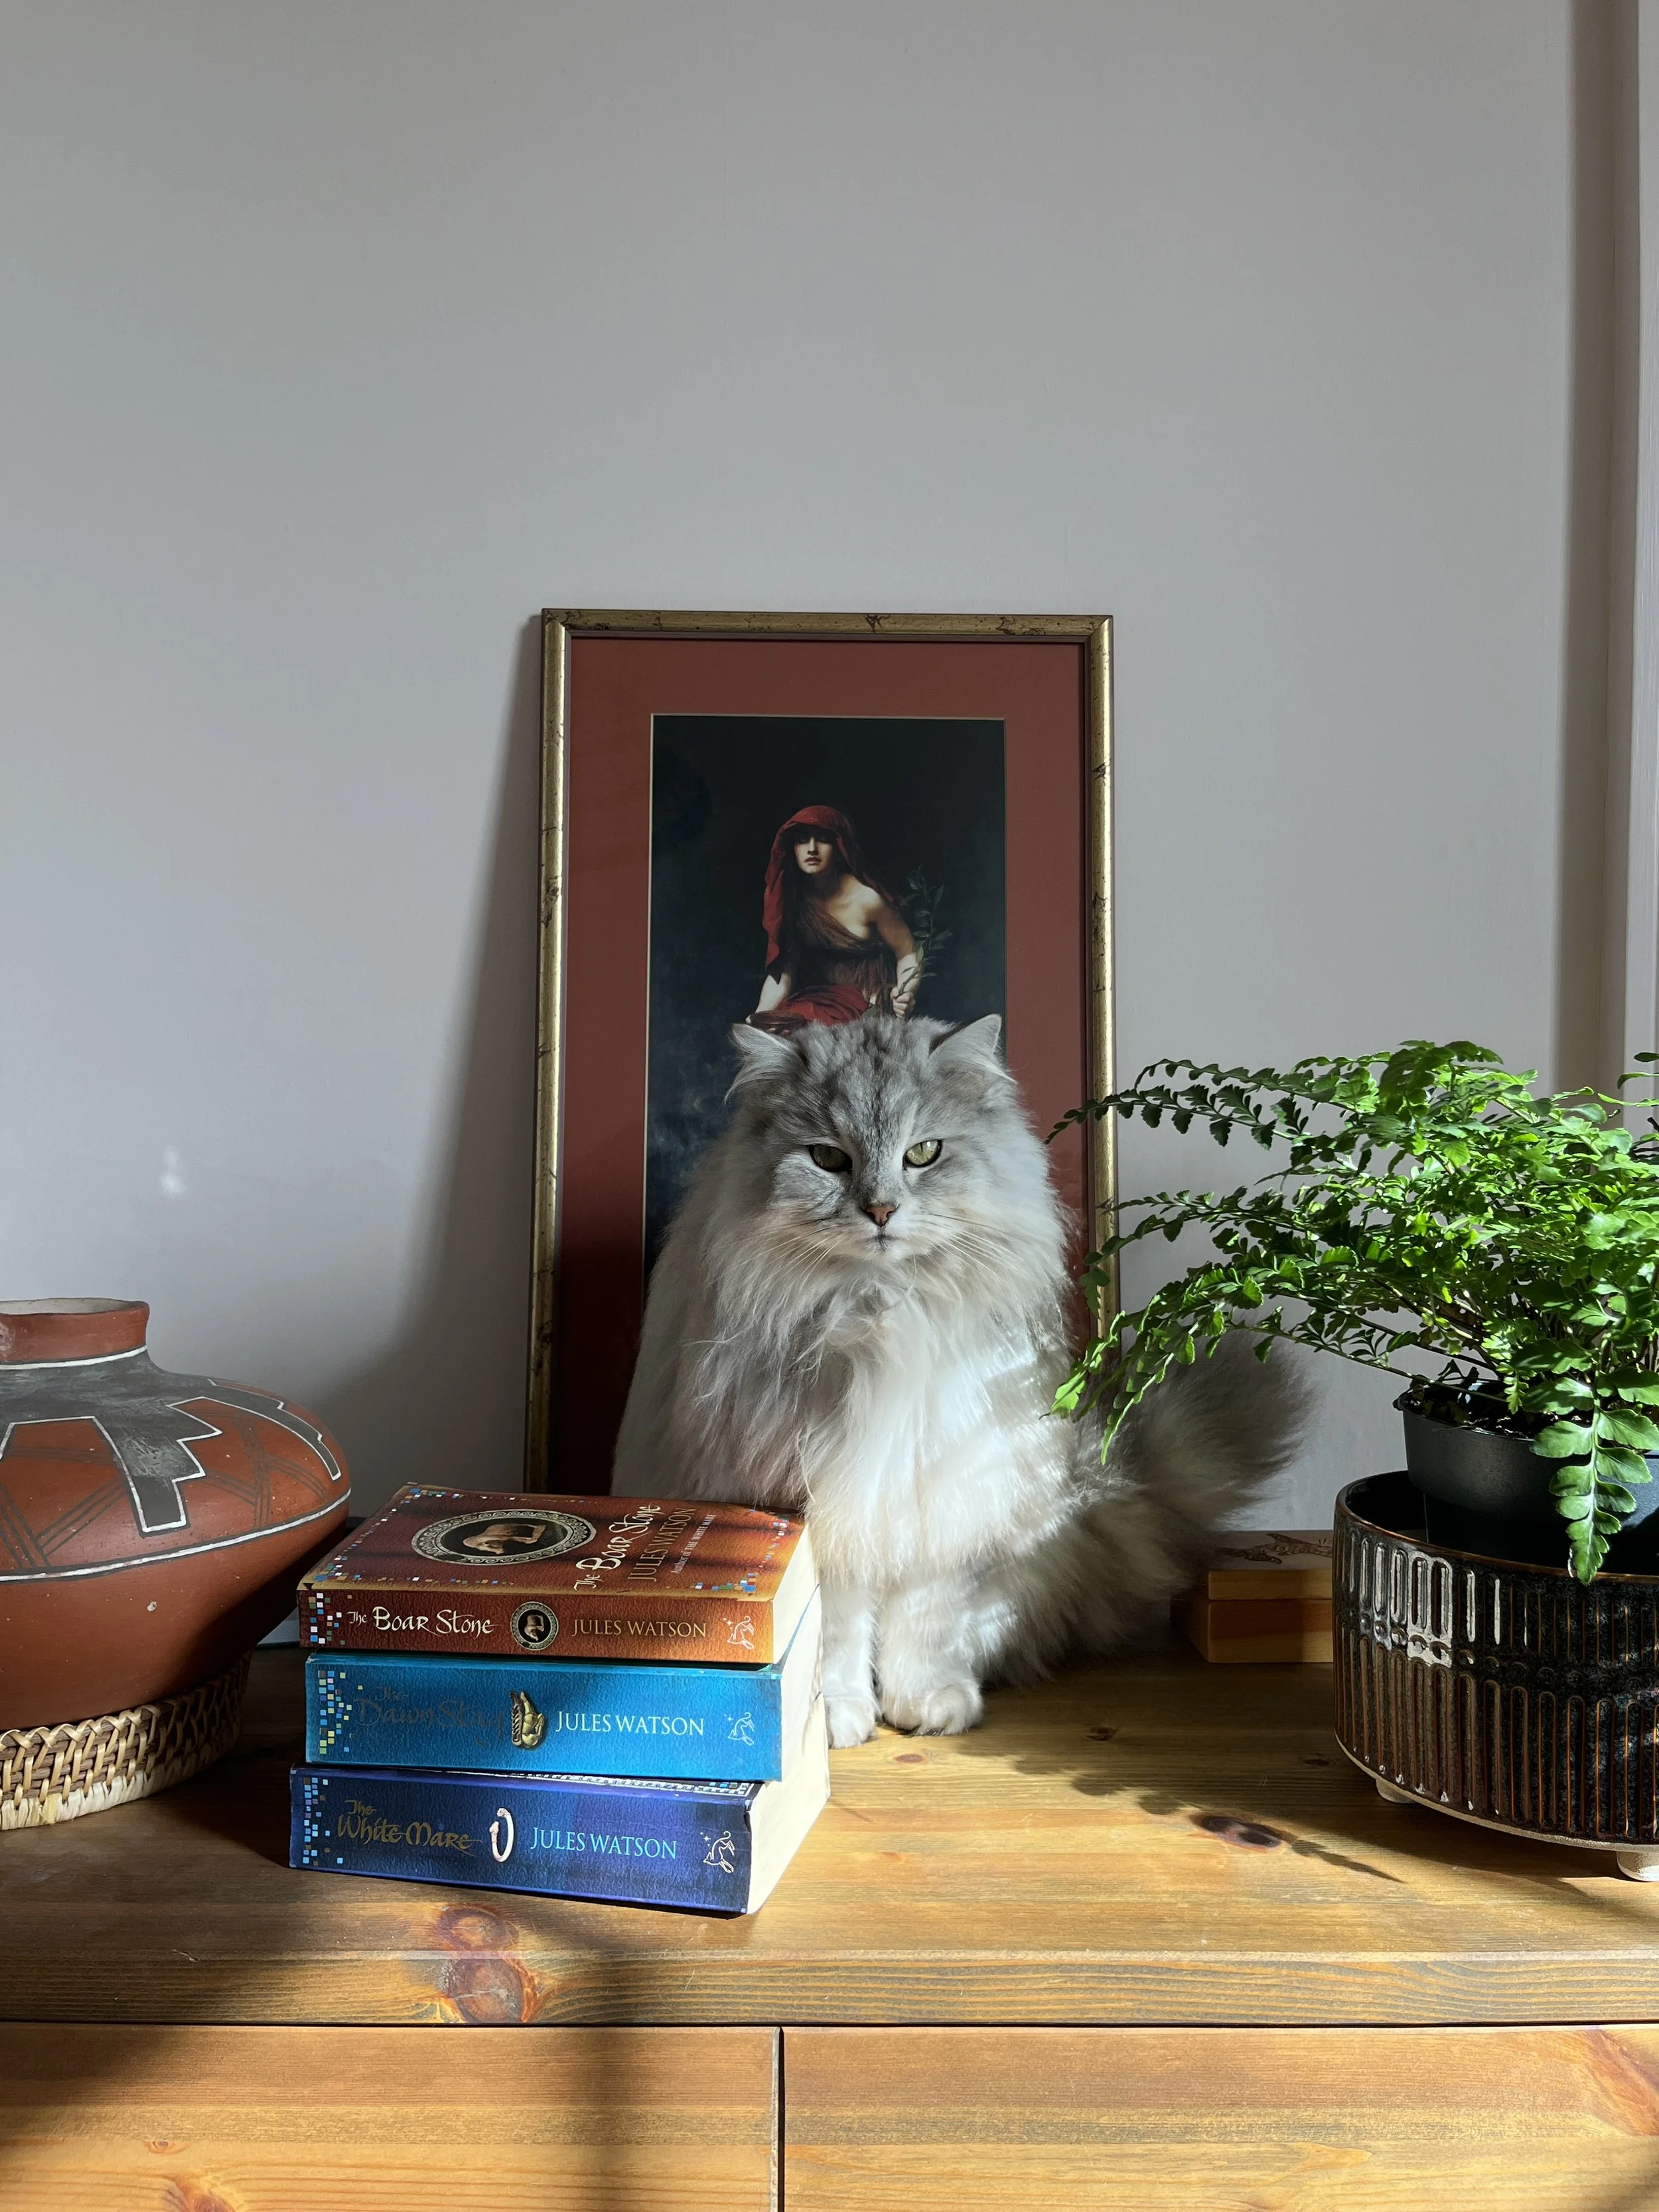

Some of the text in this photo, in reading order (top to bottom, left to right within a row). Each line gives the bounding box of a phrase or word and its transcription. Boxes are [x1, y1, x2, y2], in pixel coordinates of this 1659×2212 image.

[627, 1507, 696, 1582] JULES WATSON
[684, 1541, 699, 1550] THE
[690, 1526, 709, 1540] WHITE
[573, 1573, 605, 1591] The
[608, 1501, 666, 1534] Stone
[670, 1556, 689, 1574] Author
[346, 1611, 368, 1626] The
[435, 1609, 504, 1640] Stone
[571, 1619, 707, 1639] JULES WATSON
[555, 1711, 704, 1736] JULES WATSON
[344, 1799, 378, 1817] The
[337, 1814, 407, 1845] White
[530, 1827, 677, 1860] JULES WATSON
